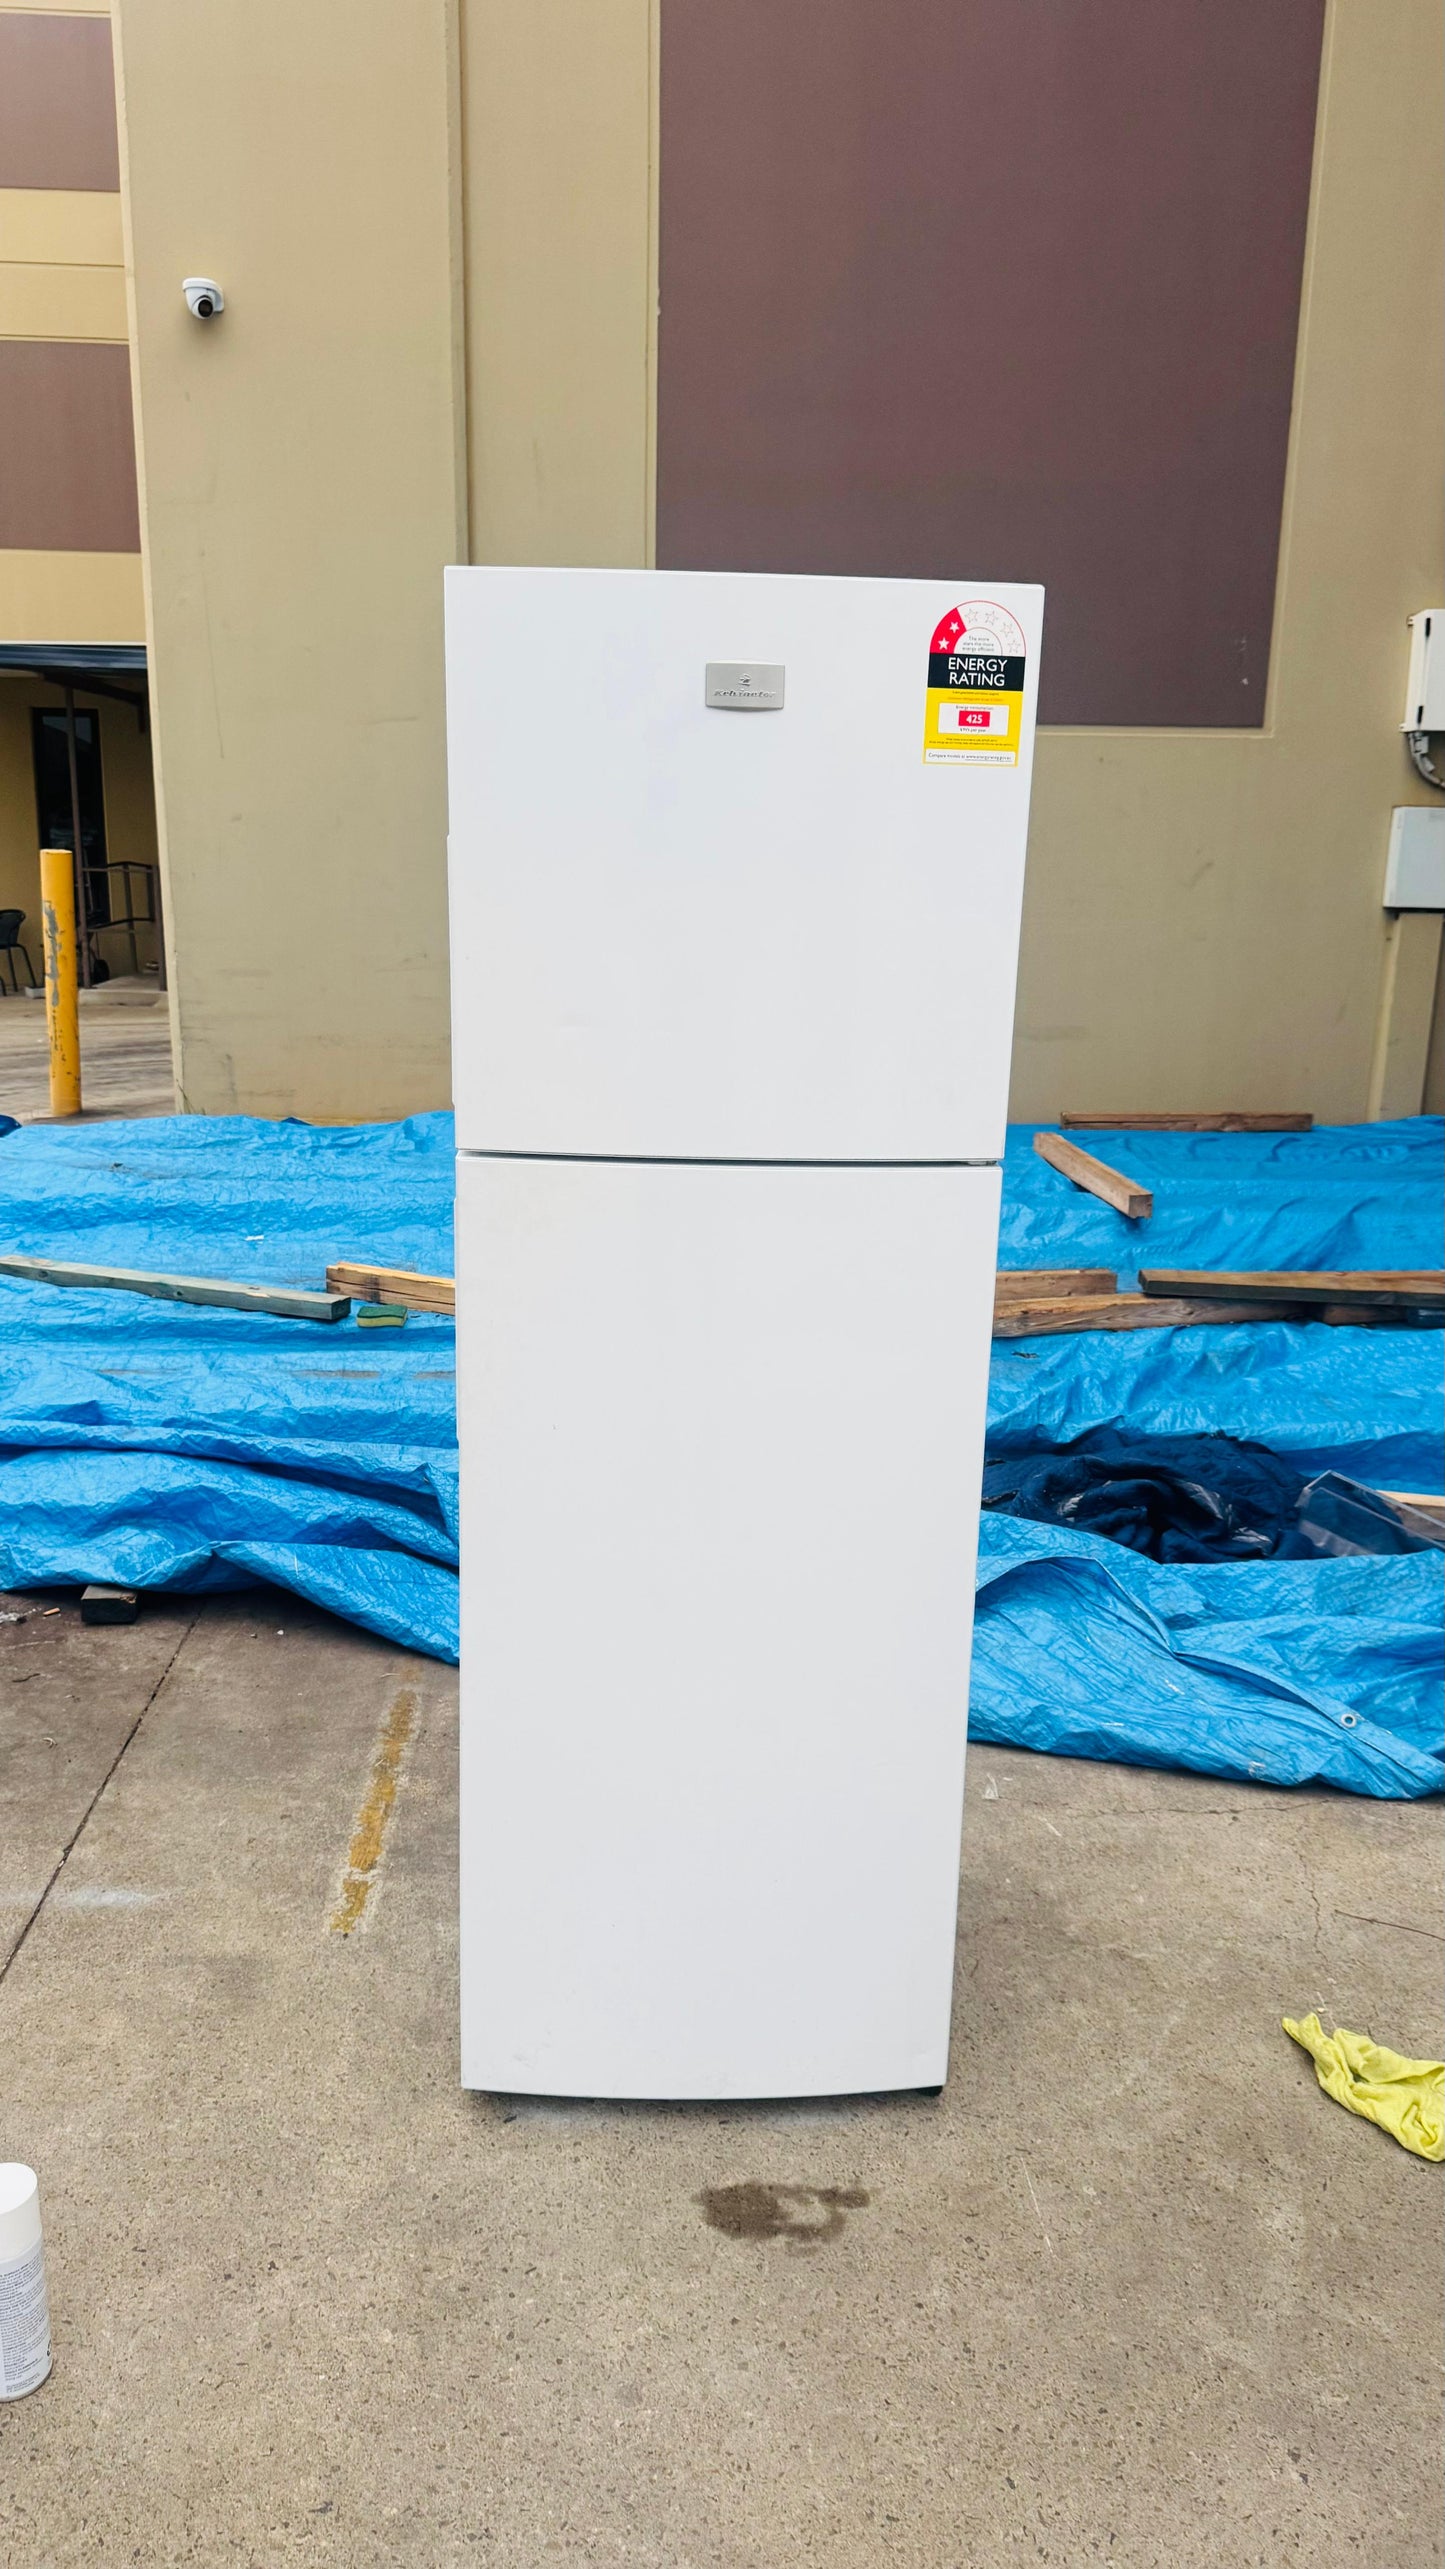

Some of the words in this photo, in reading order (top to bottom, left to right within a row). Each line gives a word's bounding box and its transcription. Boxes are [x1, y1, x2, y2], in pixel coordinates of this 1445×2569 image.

[948, 657, 1008, 672] ENERGY
[949, 672, 1006, 686] RATING
[966, 714, 983, 724] 425
